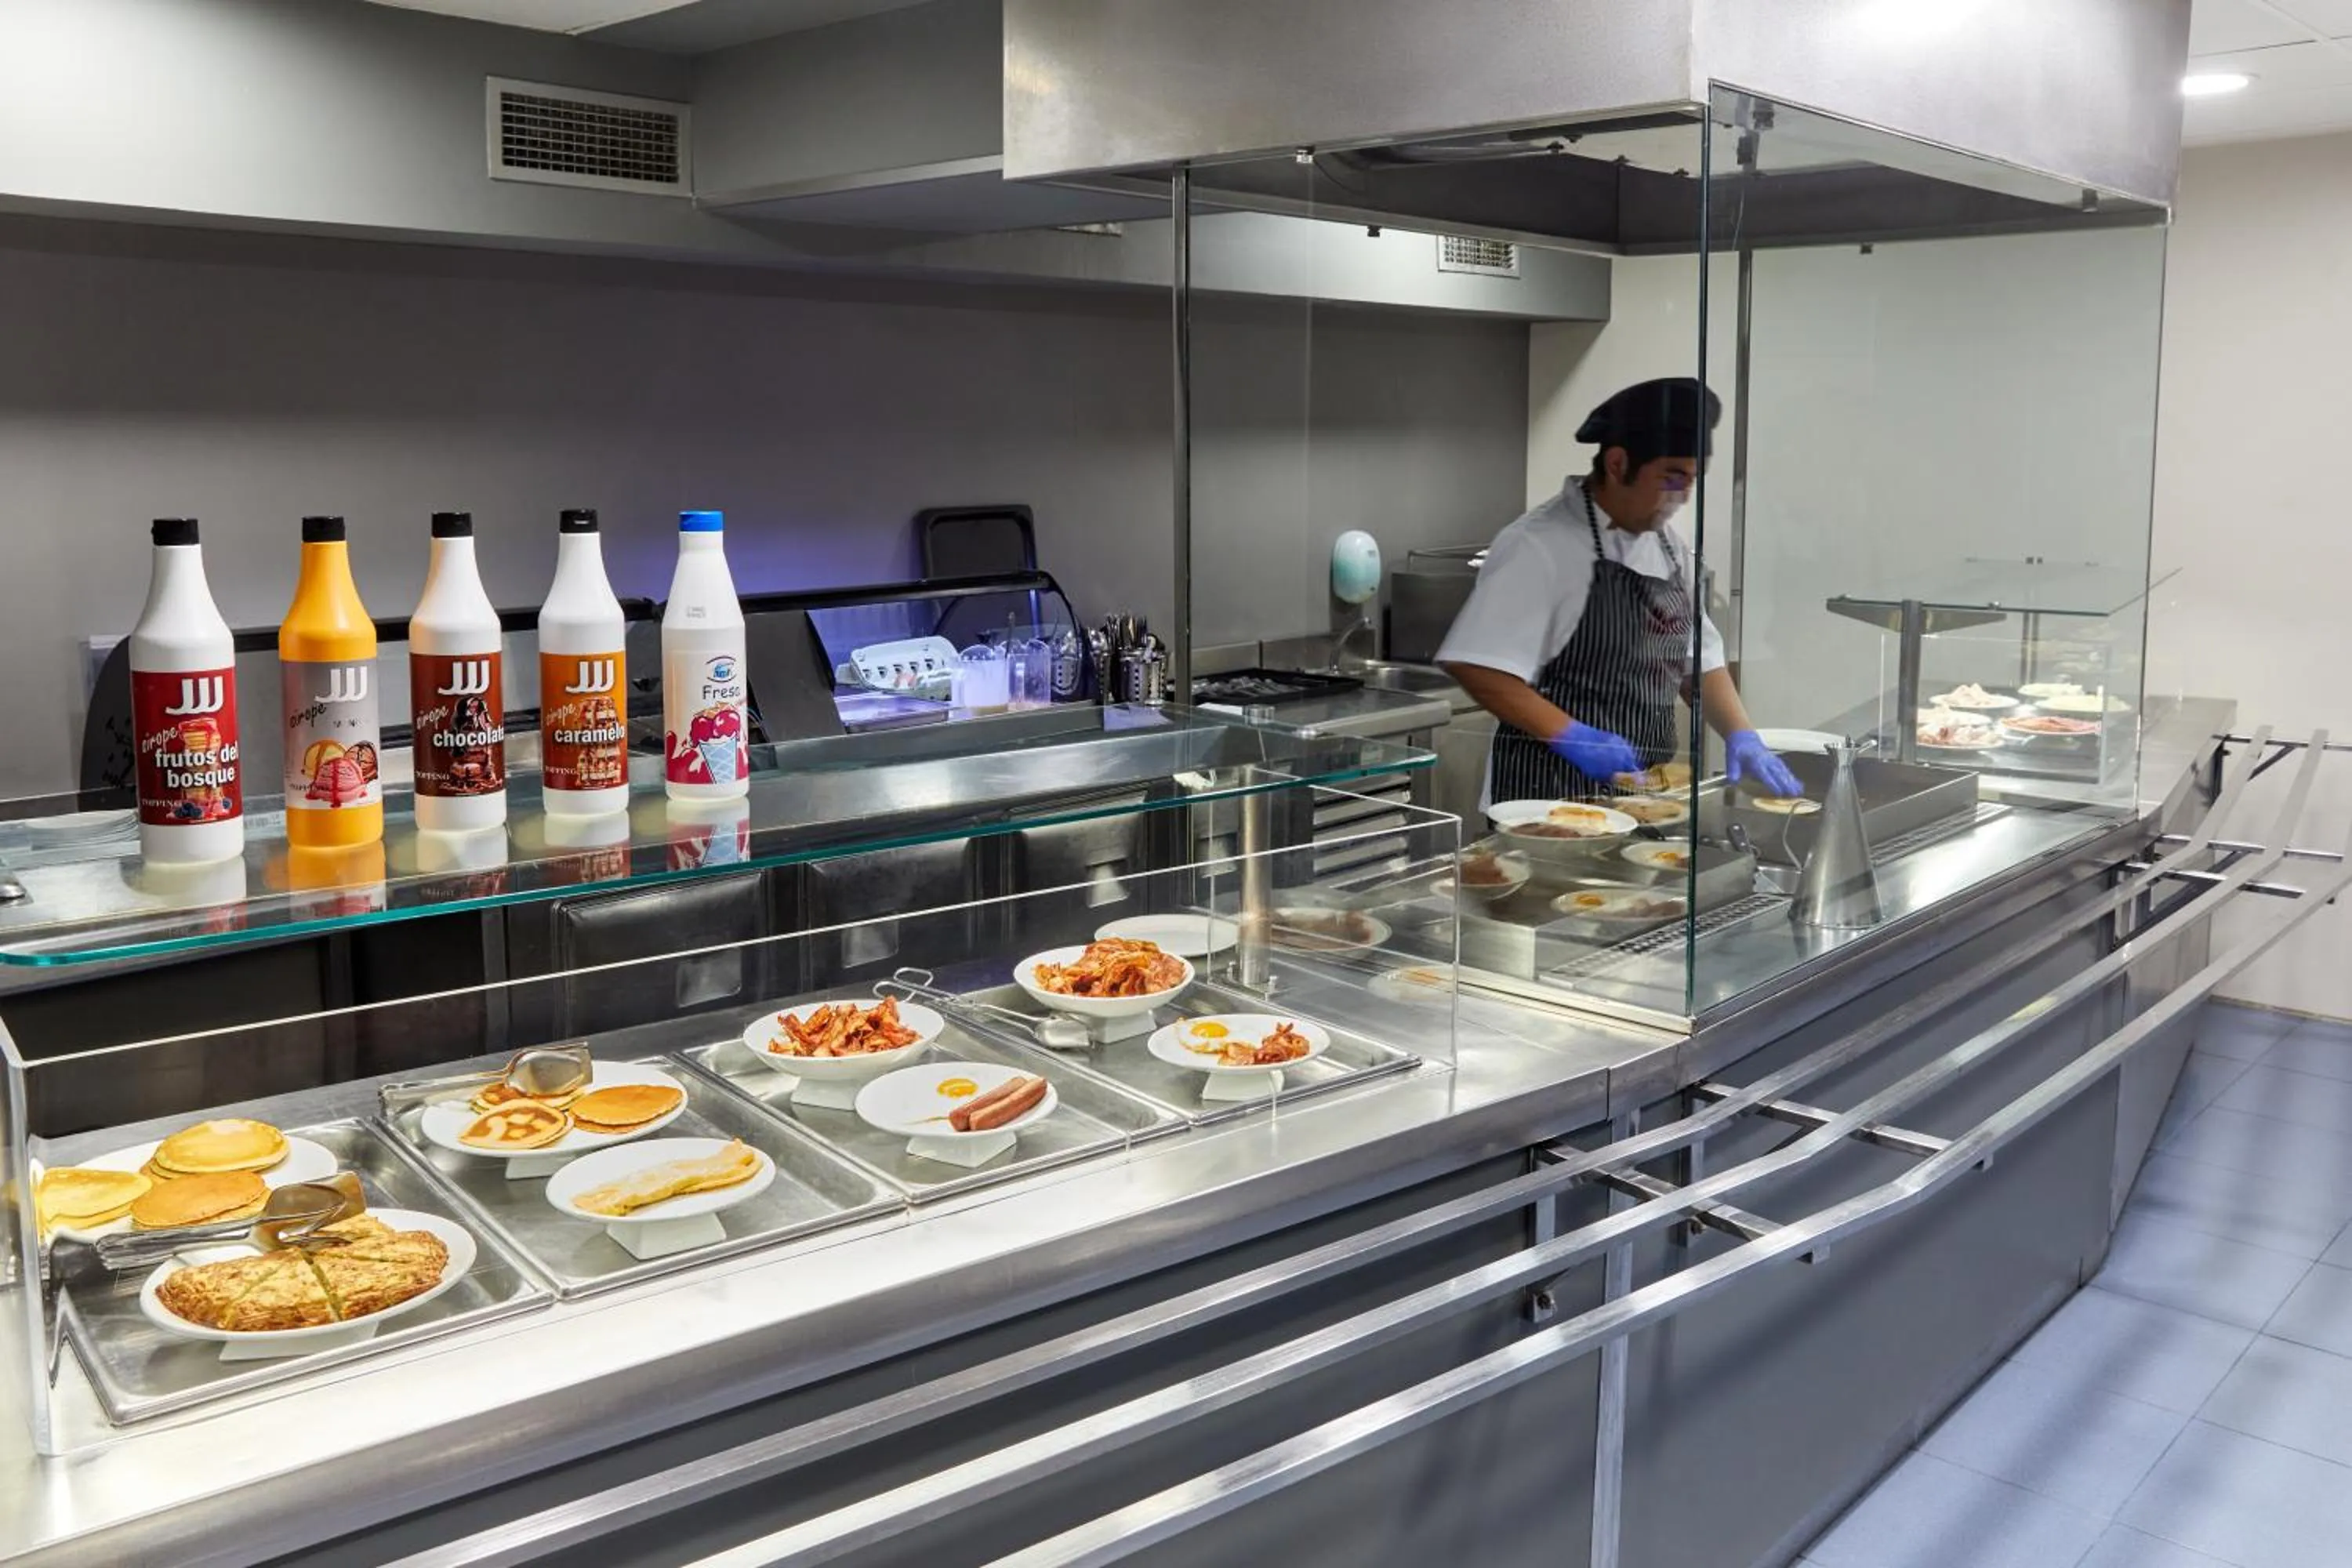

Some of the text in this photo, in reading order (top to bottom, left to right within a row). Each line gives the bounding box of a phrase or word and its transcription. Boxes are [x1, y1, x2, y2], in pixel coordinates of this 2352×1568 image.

[554, 721, 626, 743] caramelo
[154, 741, 239, 768] frutos del
[167, 767, 235, 789] bosque
